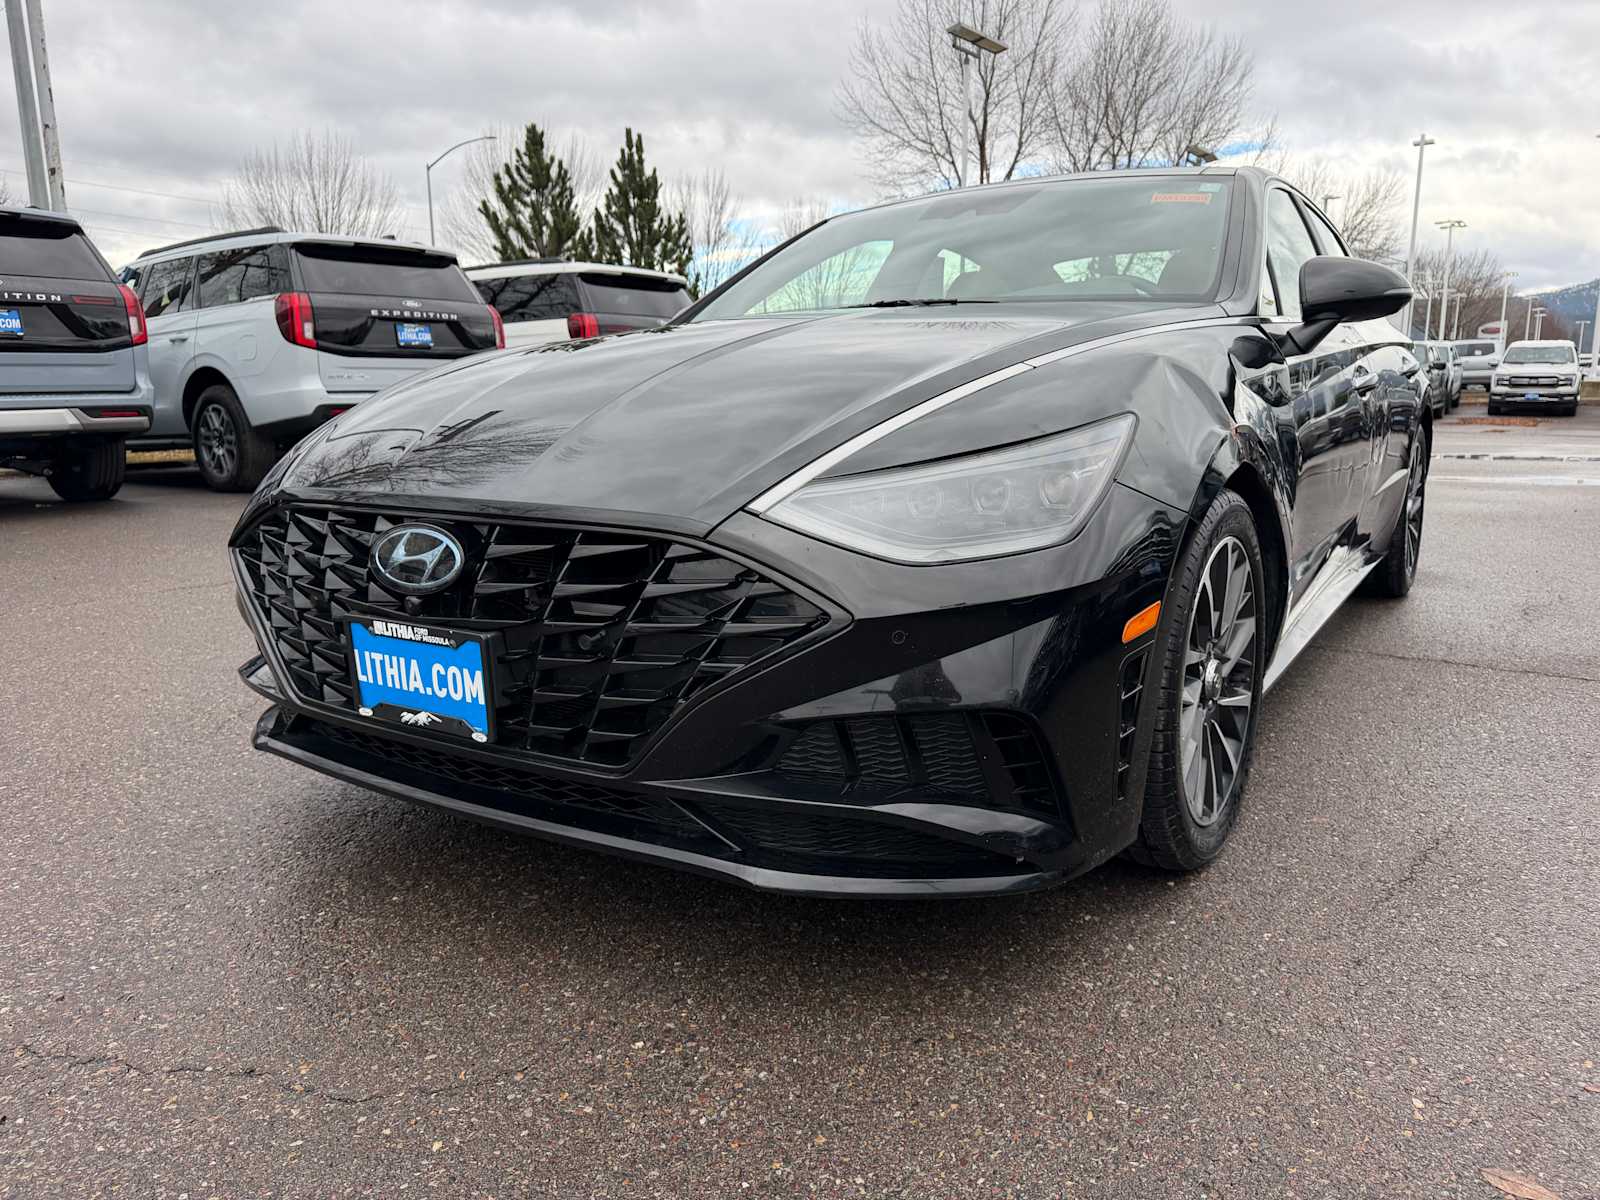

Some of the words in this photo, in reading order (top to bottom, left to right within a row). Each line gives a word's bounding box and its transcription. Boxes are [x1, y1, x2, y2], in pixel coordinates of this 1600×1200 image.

[370, 309, 458, 320] EXPEDITION
[383, 621, 415, 640] LITHIA
[414, 627, 428, 636] FORD
[422, 635, 450, 646] MISSOULA
[354, 649, 486, 705] LITHIA.COM
